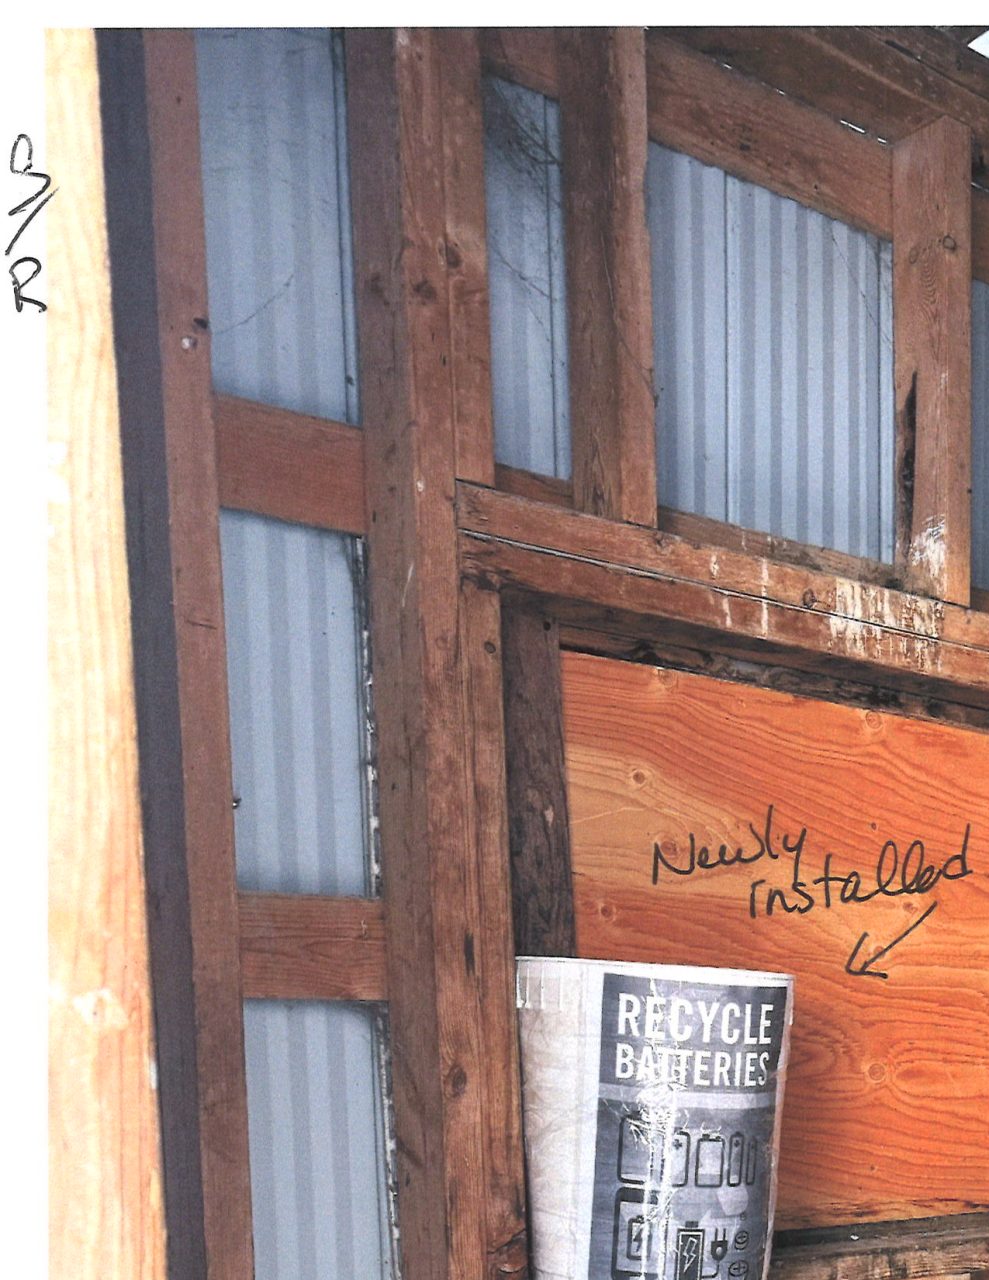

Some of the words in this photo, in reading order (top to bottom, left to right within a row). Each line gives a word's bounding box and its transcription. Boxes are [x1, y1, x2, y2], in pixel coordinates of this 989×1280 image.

[652, 804, 807, 885] Newly
[750, 822, 974, 919] installed
[617, 992, 775, 1046] RECYCLE
[615, 1042, 771, 1088] BATTERIES
